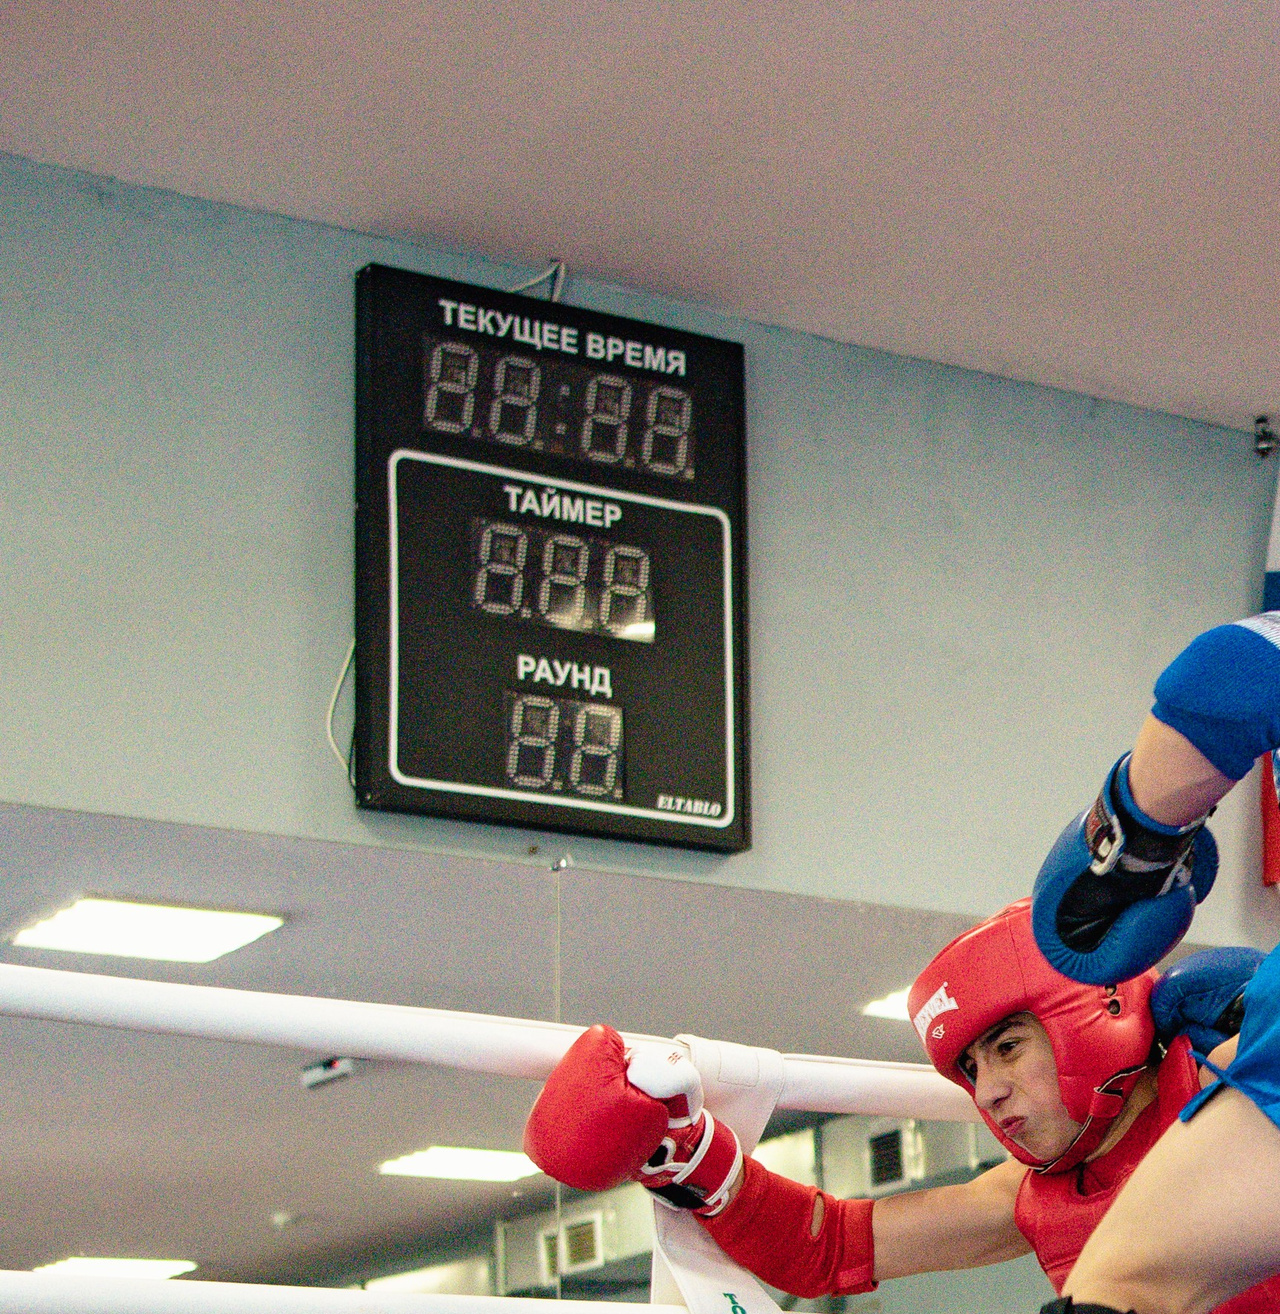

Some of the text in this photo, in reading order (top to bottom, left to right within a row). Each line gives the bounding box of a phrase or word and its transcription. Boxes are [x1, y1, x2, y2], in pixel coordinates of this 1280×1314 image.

[438, 299, 687, 377] ТЕКУЩЕЕ ВРЕМЯ
[503, 484, 622, 529] ТАЙМЕР
[516, 653, 612, 698] РАУНД
